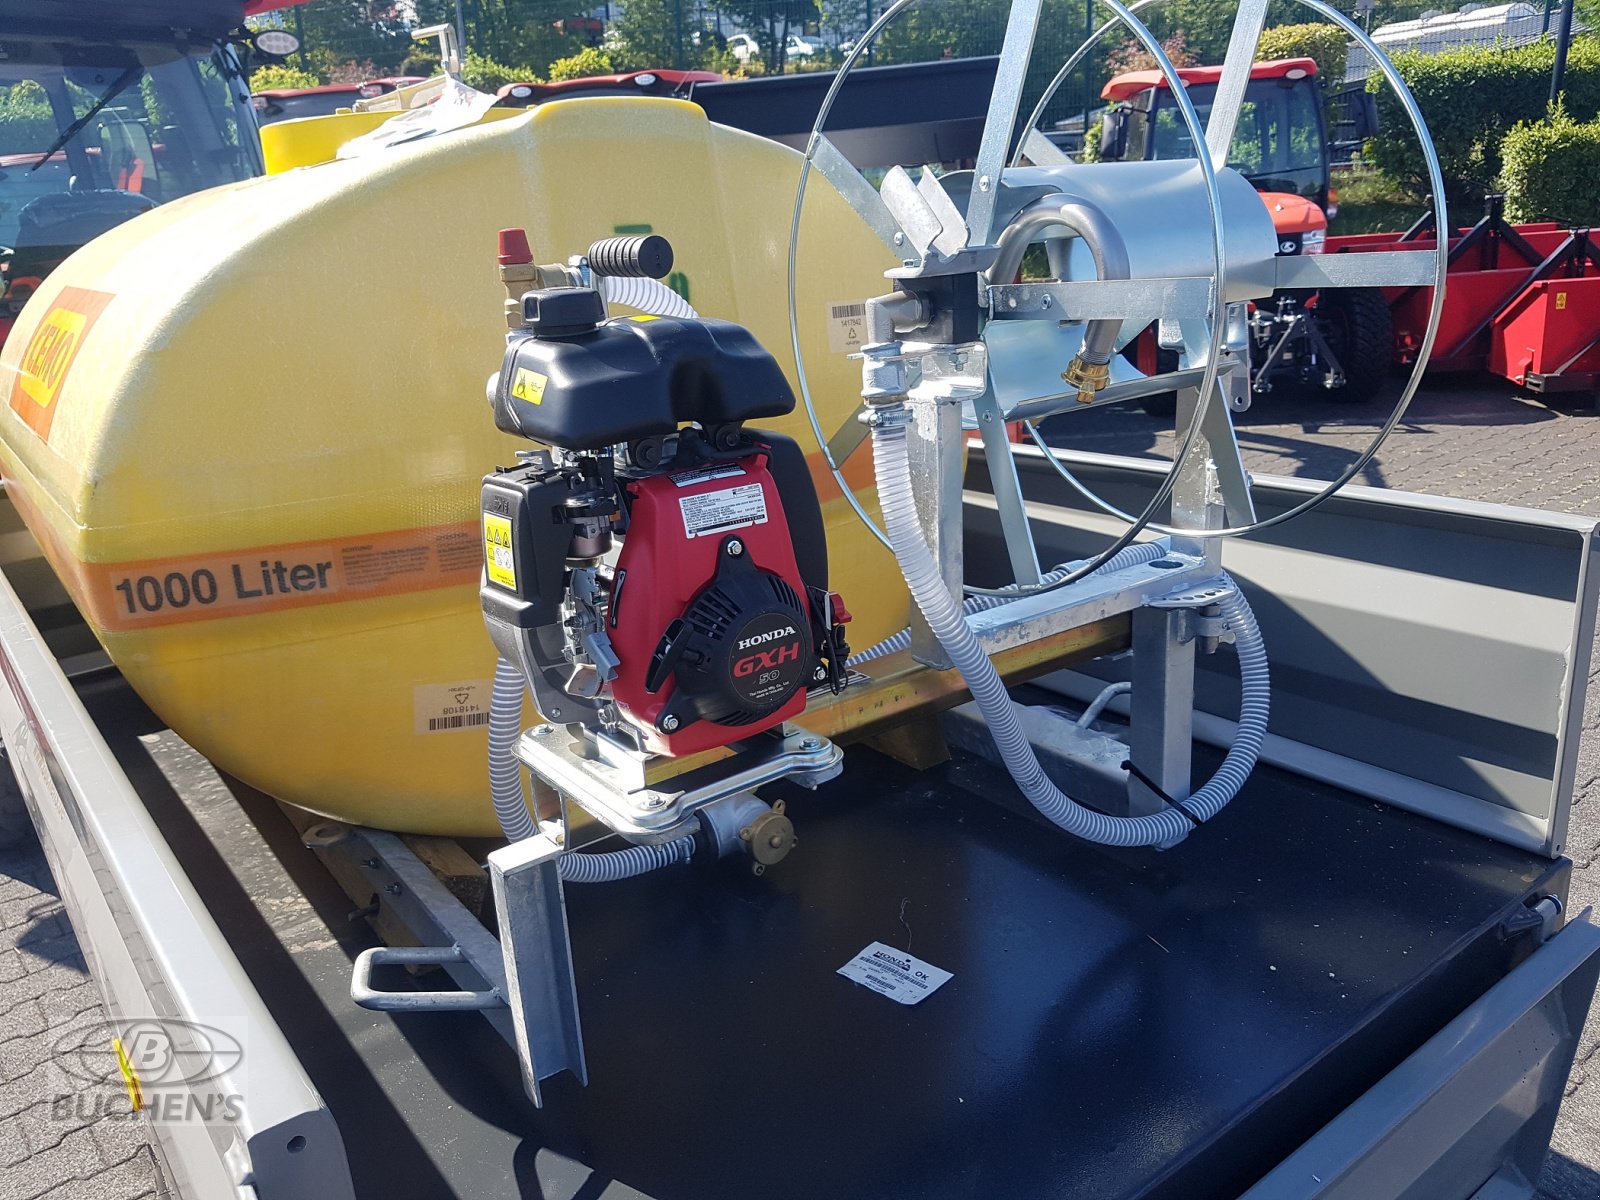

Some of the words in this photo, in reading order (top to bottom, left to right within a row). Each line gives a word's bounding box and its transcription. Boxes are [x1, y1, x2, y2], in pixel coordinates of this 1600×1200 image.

[26, 323, 75, 390] CEMO
[115, 568, 218, 614] 1000
[231, 560, 332, 600] Liter
[737, 626, 796, 650] HONDA
[733, 641, 799, 678] GXH
[758, 669, 780, 685] 50
[443, 704, 480, 715] 1418108
[874, 951, 912, 969] HONDA
[914, 970, 930, 981] OK
